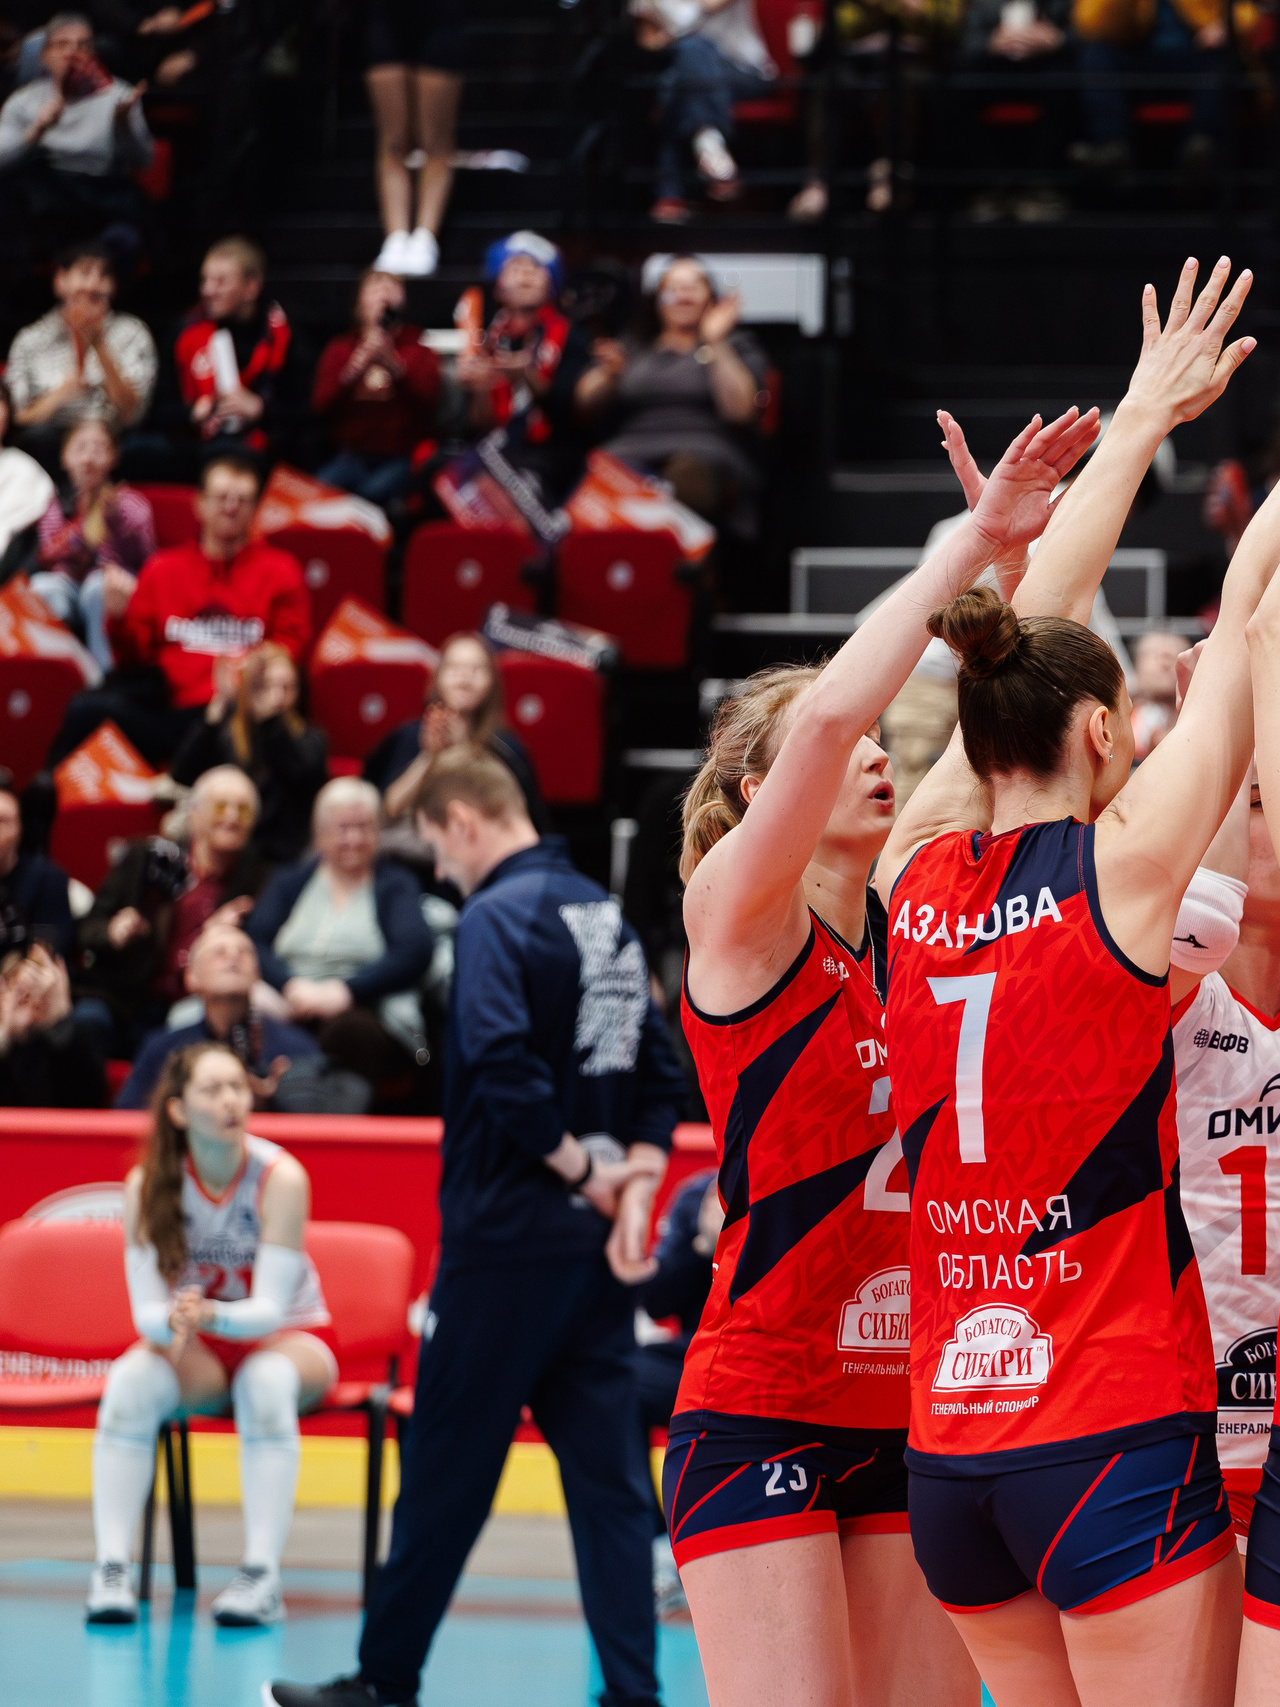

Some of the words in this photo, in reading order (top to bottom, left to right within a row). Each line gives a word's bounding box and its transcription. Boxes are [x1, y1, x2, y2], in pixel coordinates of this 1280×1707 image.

[892, 886, 1062, 949] АЗАНОВА
[1208, 1030, 1249, 1054] ВФВ
[925, 971, 998, 1164] 7
[926, 1194, 1072, 1235] ОМСКАЯ
[937, 1249, 1083, 1290] ОБЛАСТЬ
[842, 1361, 905, 1376] ГЕНЕРАЛЬНЫЙ
[931, 1399, 993, 1416] ГЕНЕРАЛЬНЫЙ
